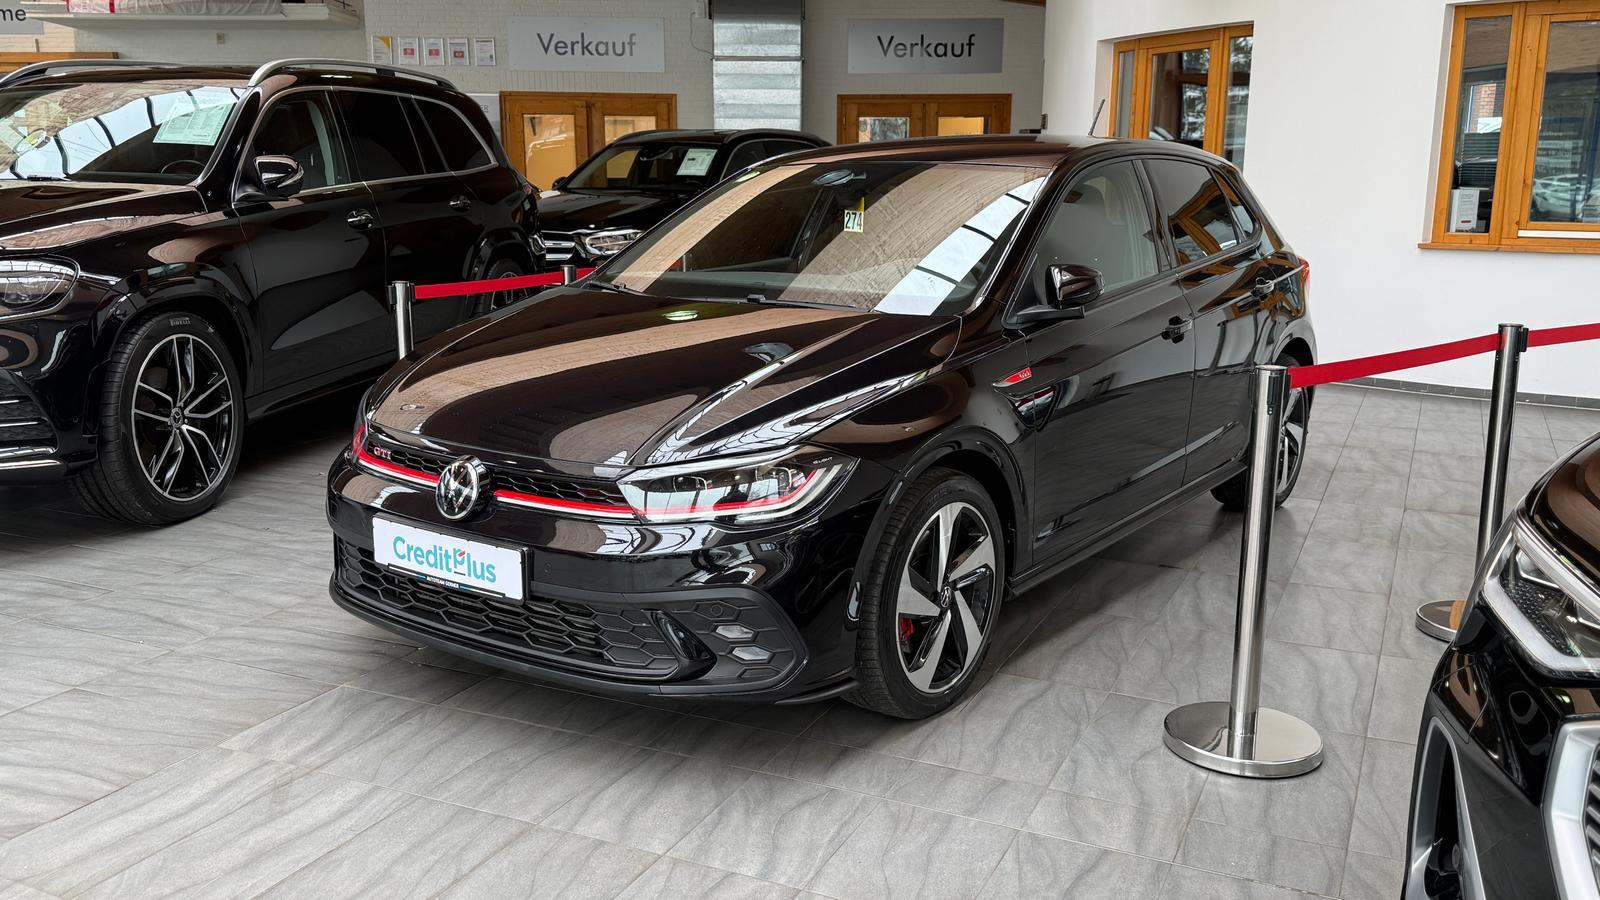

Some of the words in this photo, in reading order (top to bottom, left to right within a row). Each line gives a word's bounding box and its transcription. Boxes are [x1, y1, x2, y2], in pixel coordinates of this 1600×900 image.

[536, 32, 637, 57] Verkauf
[876, 33, 976, 58] Verkauf
[845, 211, 862, 230] 274
[373, 446, 392, 460] GTI
[393, 536, 497, 583] CreditPlus
